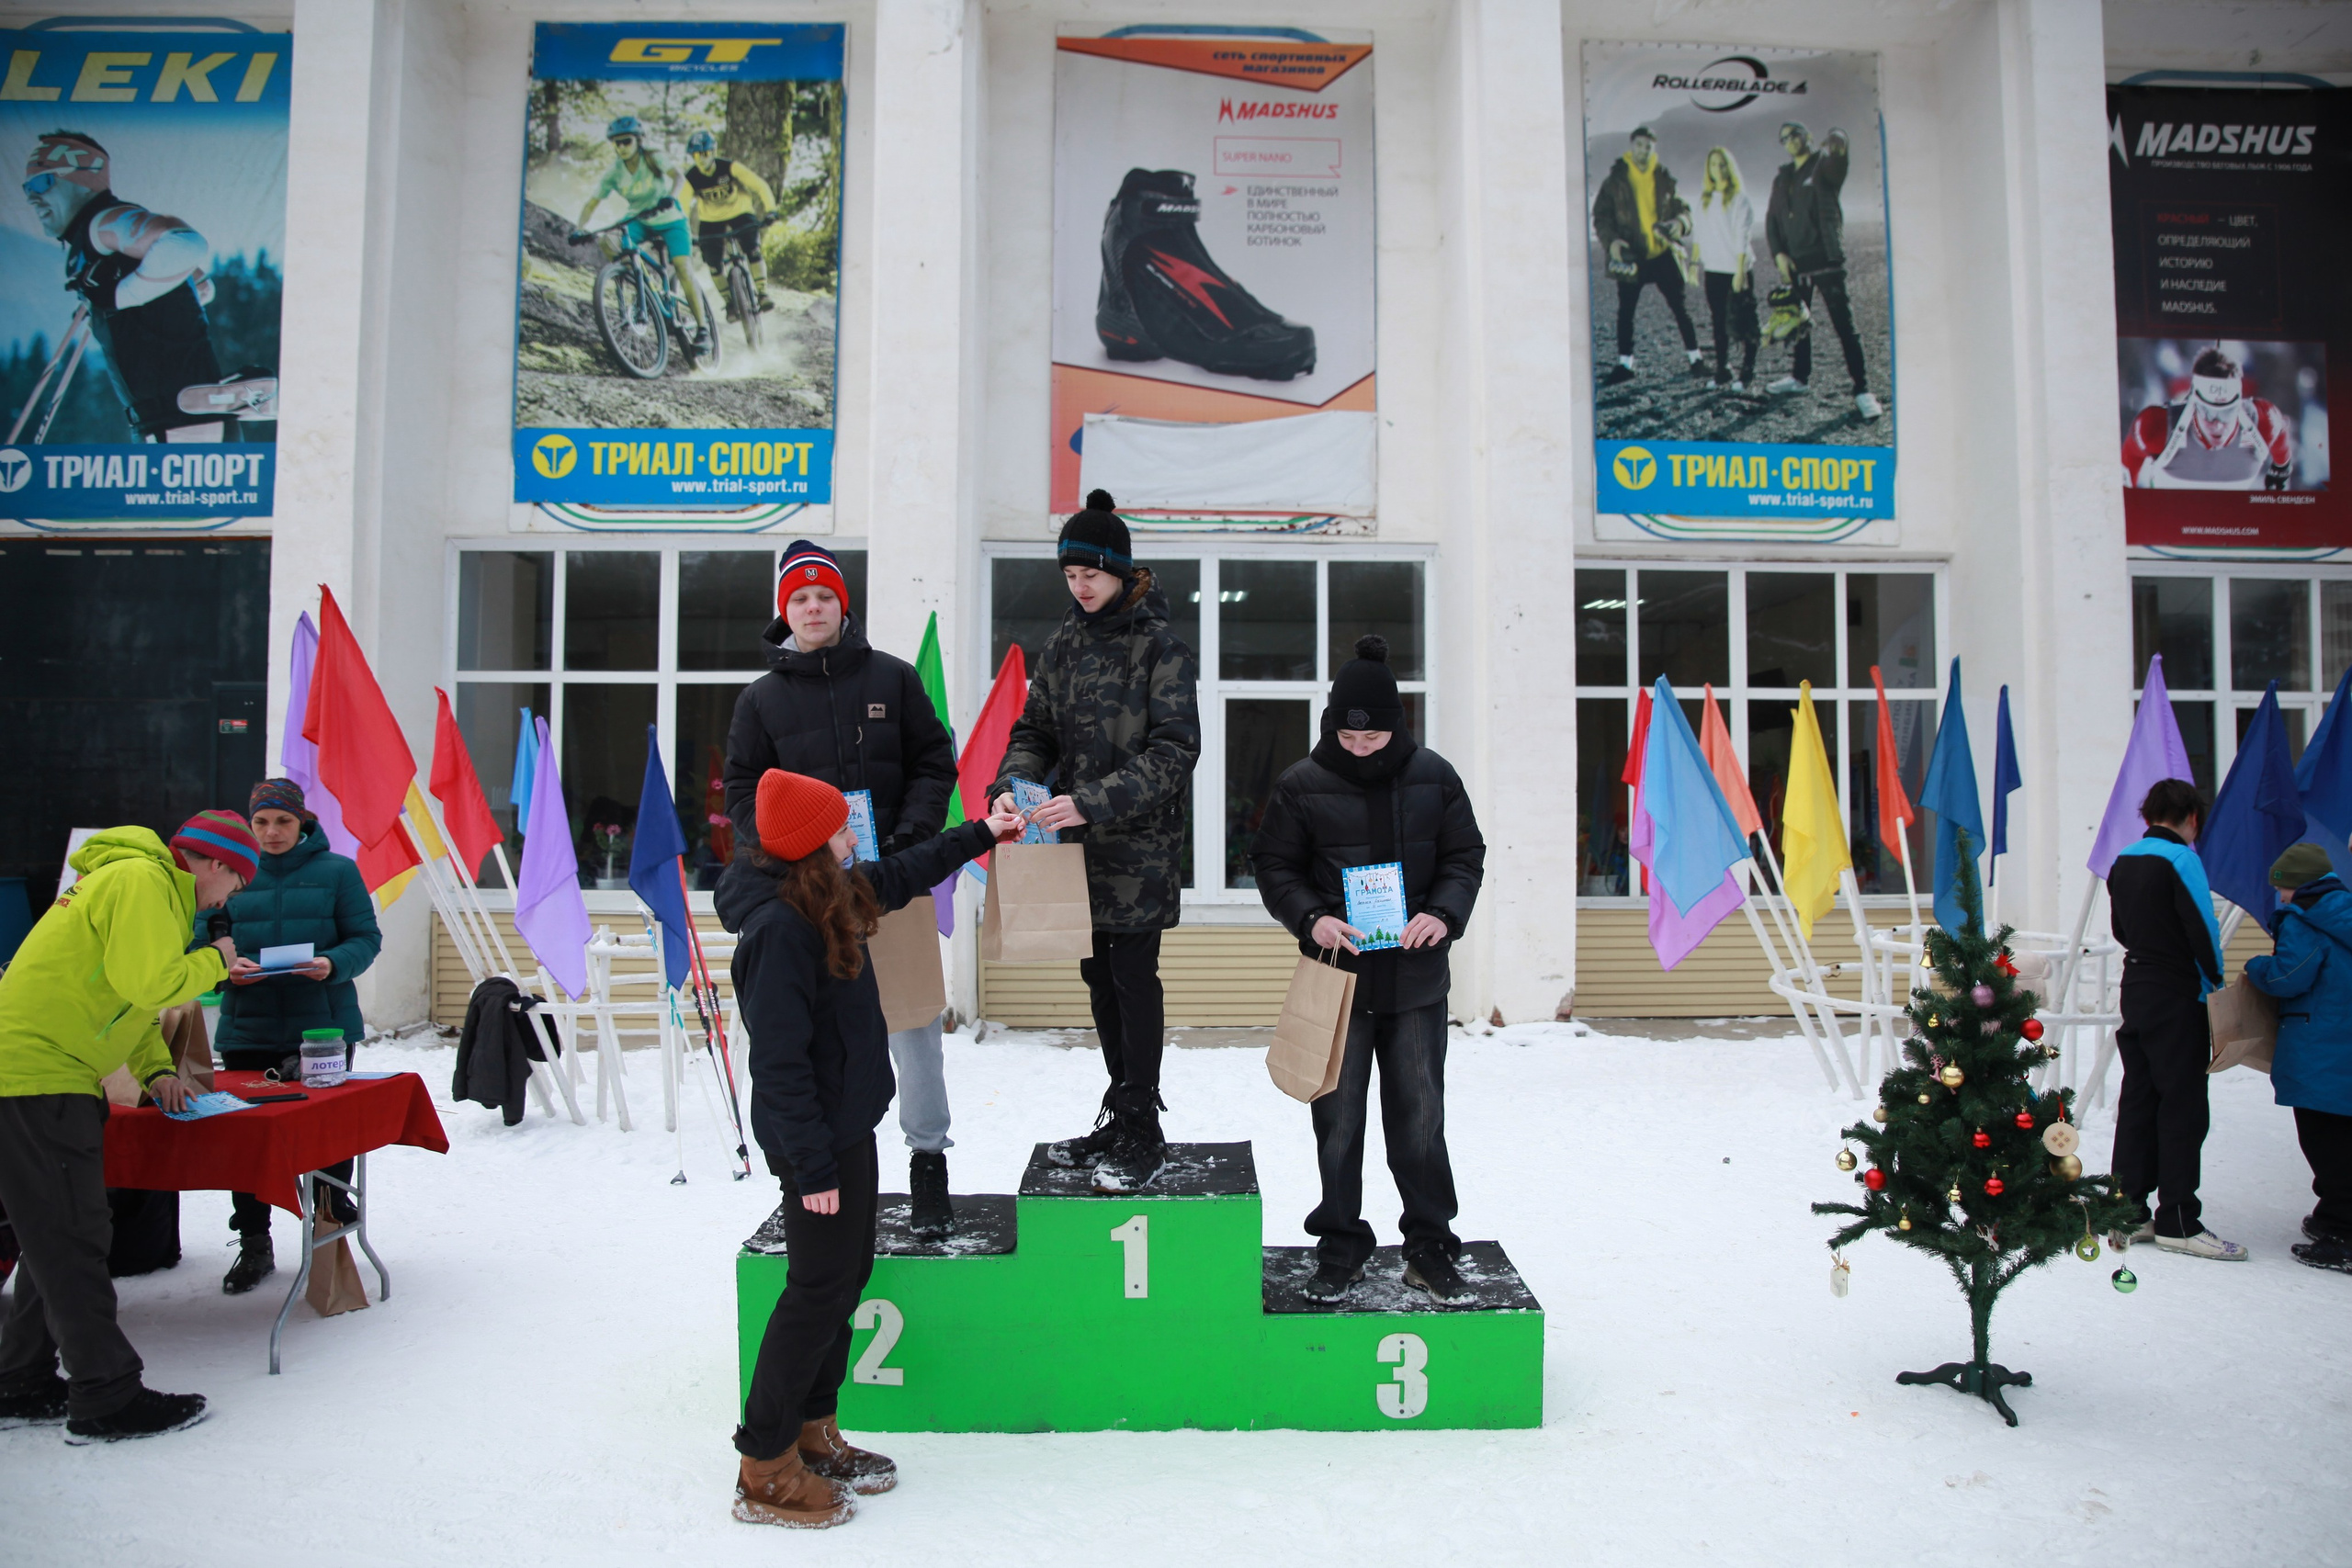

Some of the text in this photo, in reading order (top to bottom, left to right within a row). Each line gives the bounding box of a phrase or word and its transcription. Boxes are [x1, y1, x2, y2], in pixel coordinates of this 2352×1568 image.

[609, 39, 782, 62] GT
[1214, 51, 1347, 63] сеть спортивных
[0, 50, 278, 103] LEKI
[1242, 64, 1325, 73] магазинов
[1652, 74, 1790, 94] ROLLERBLADE
[1237, 102, 1339, 119] MADSHUS
[2134, 121, 2317, 157] MADSHUS
[1222, 152, 1293, 163] SUPER NANO
[1247, 186, 1339, 197] ЕДИНСТВЕННЫЙ
[1247, 198, 1286, 209] В МИРЕ
[1247, 209, 1320, 221] ПОЛНОСТЬЮ
[1247, 222, 1326, 234] КАРБОНОВЫЙ
[1247, 236, 1302, 246] БОТИНОК
[2157, 233, 2251, 249] ОПРЕДЕЛЯЮЩИЙ
[2159, 256, 2213, 269] ИСТОРИЮ
[2160, 278, 2227, 292] И НАСЛЕДИЕ
[672, 479, 808, 496] www.trial-sport.ru
[125, 491, 257, 507] www.trial-sport.ru
[1748, 492, 1873, 510] www.trial-sport.ru
[1355, 886, 1394, 897] ГРАМОТА
[1110, 1214, 1148, 1299] 1
[854, 1298, 905, 1386] 2
[1376, 1333, 1429, 1418] 3
